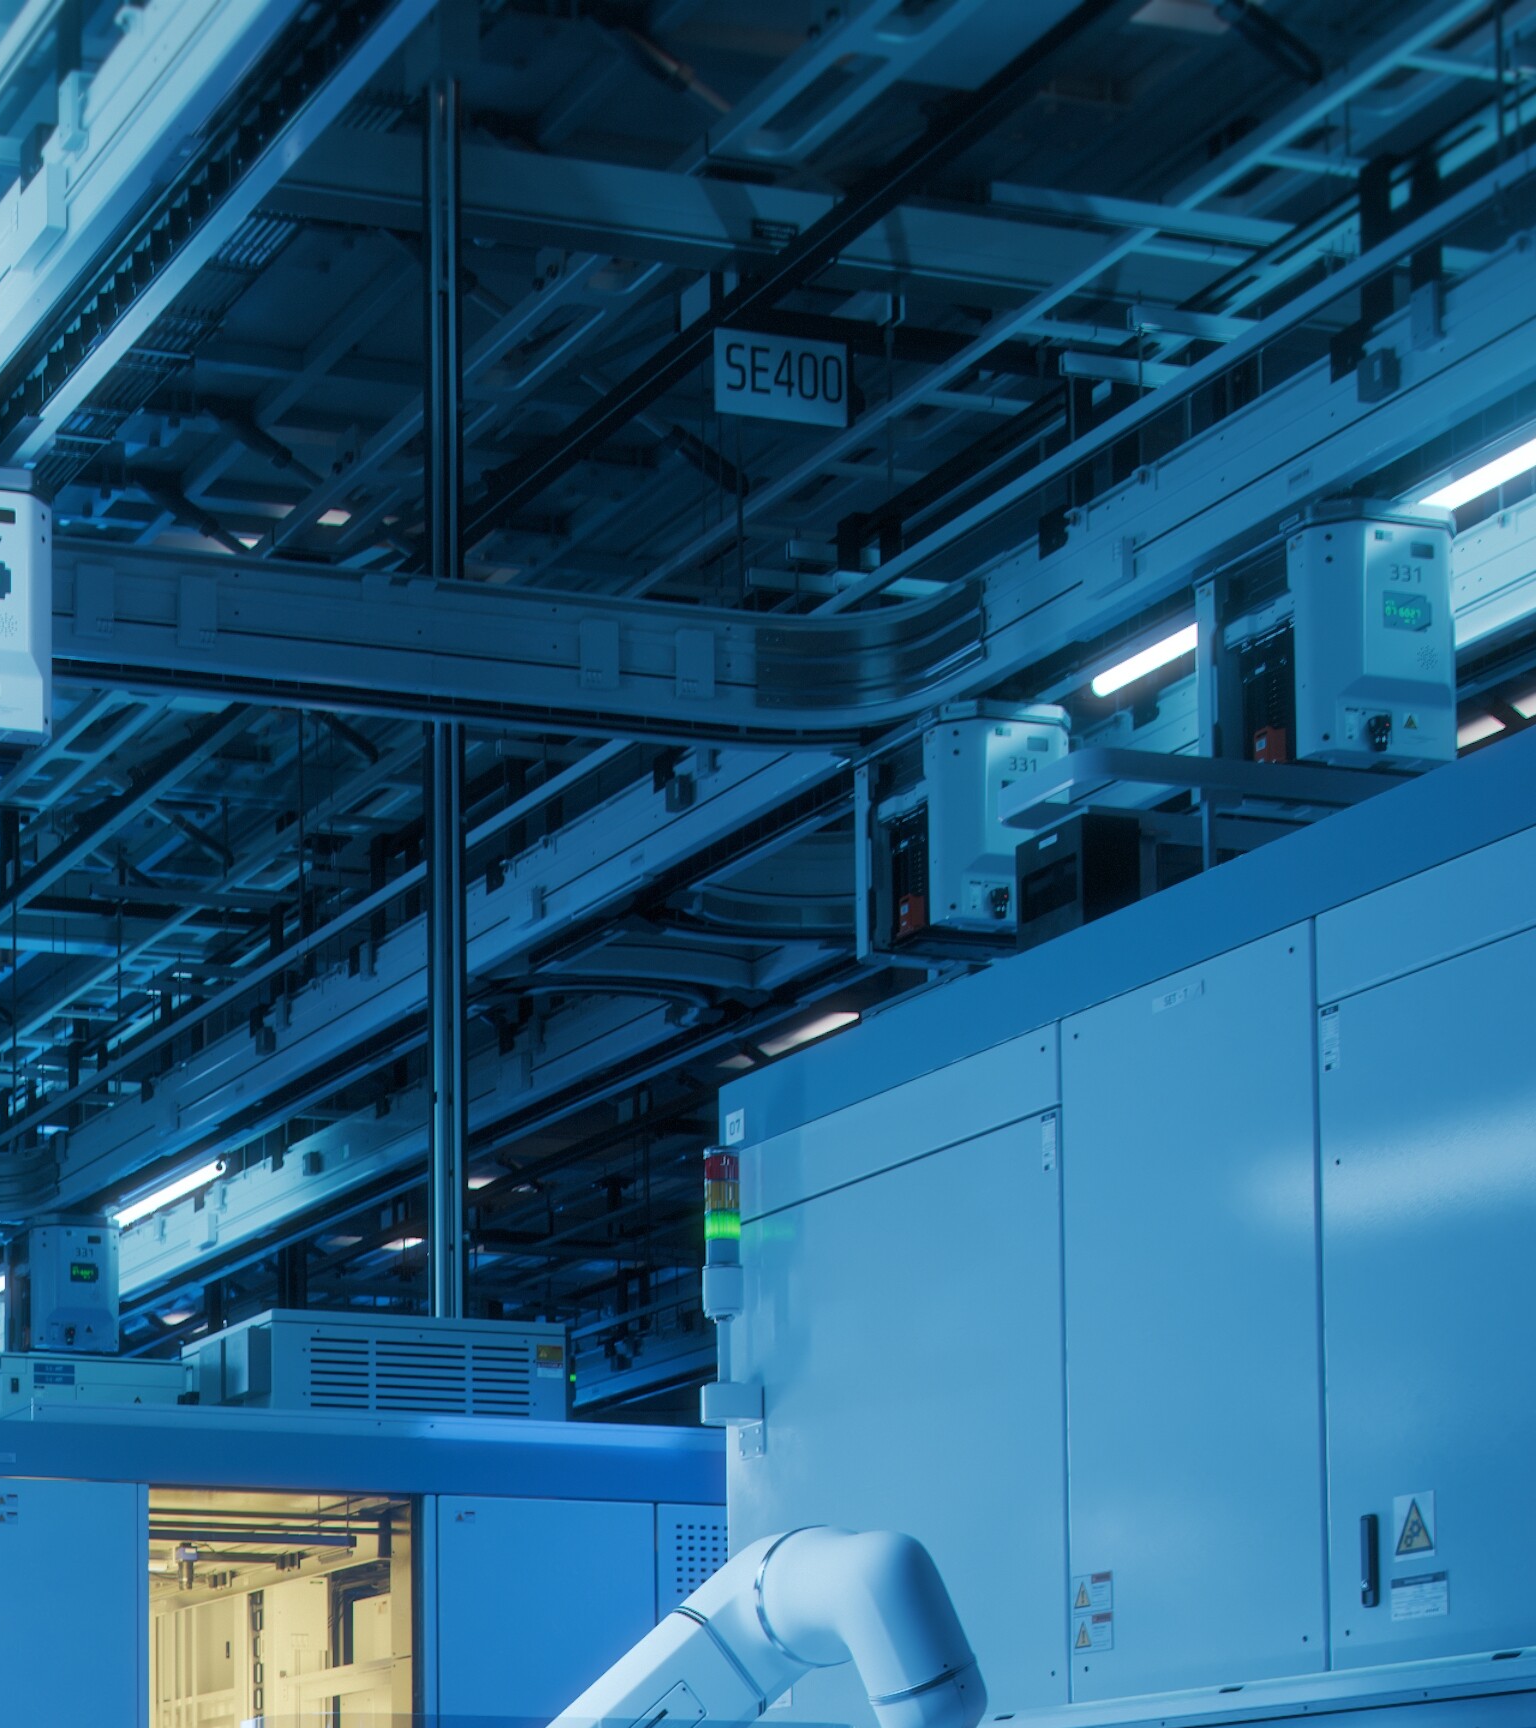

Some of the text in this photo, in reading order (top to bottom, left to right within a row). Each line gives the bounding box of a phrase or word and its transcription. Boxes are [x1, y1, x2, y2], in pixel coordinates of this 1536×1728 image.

[725, 343, 843, 403] SE400
[1389, 563, 1422, 584] 331
[1008, 756, 1038, 773] 331
